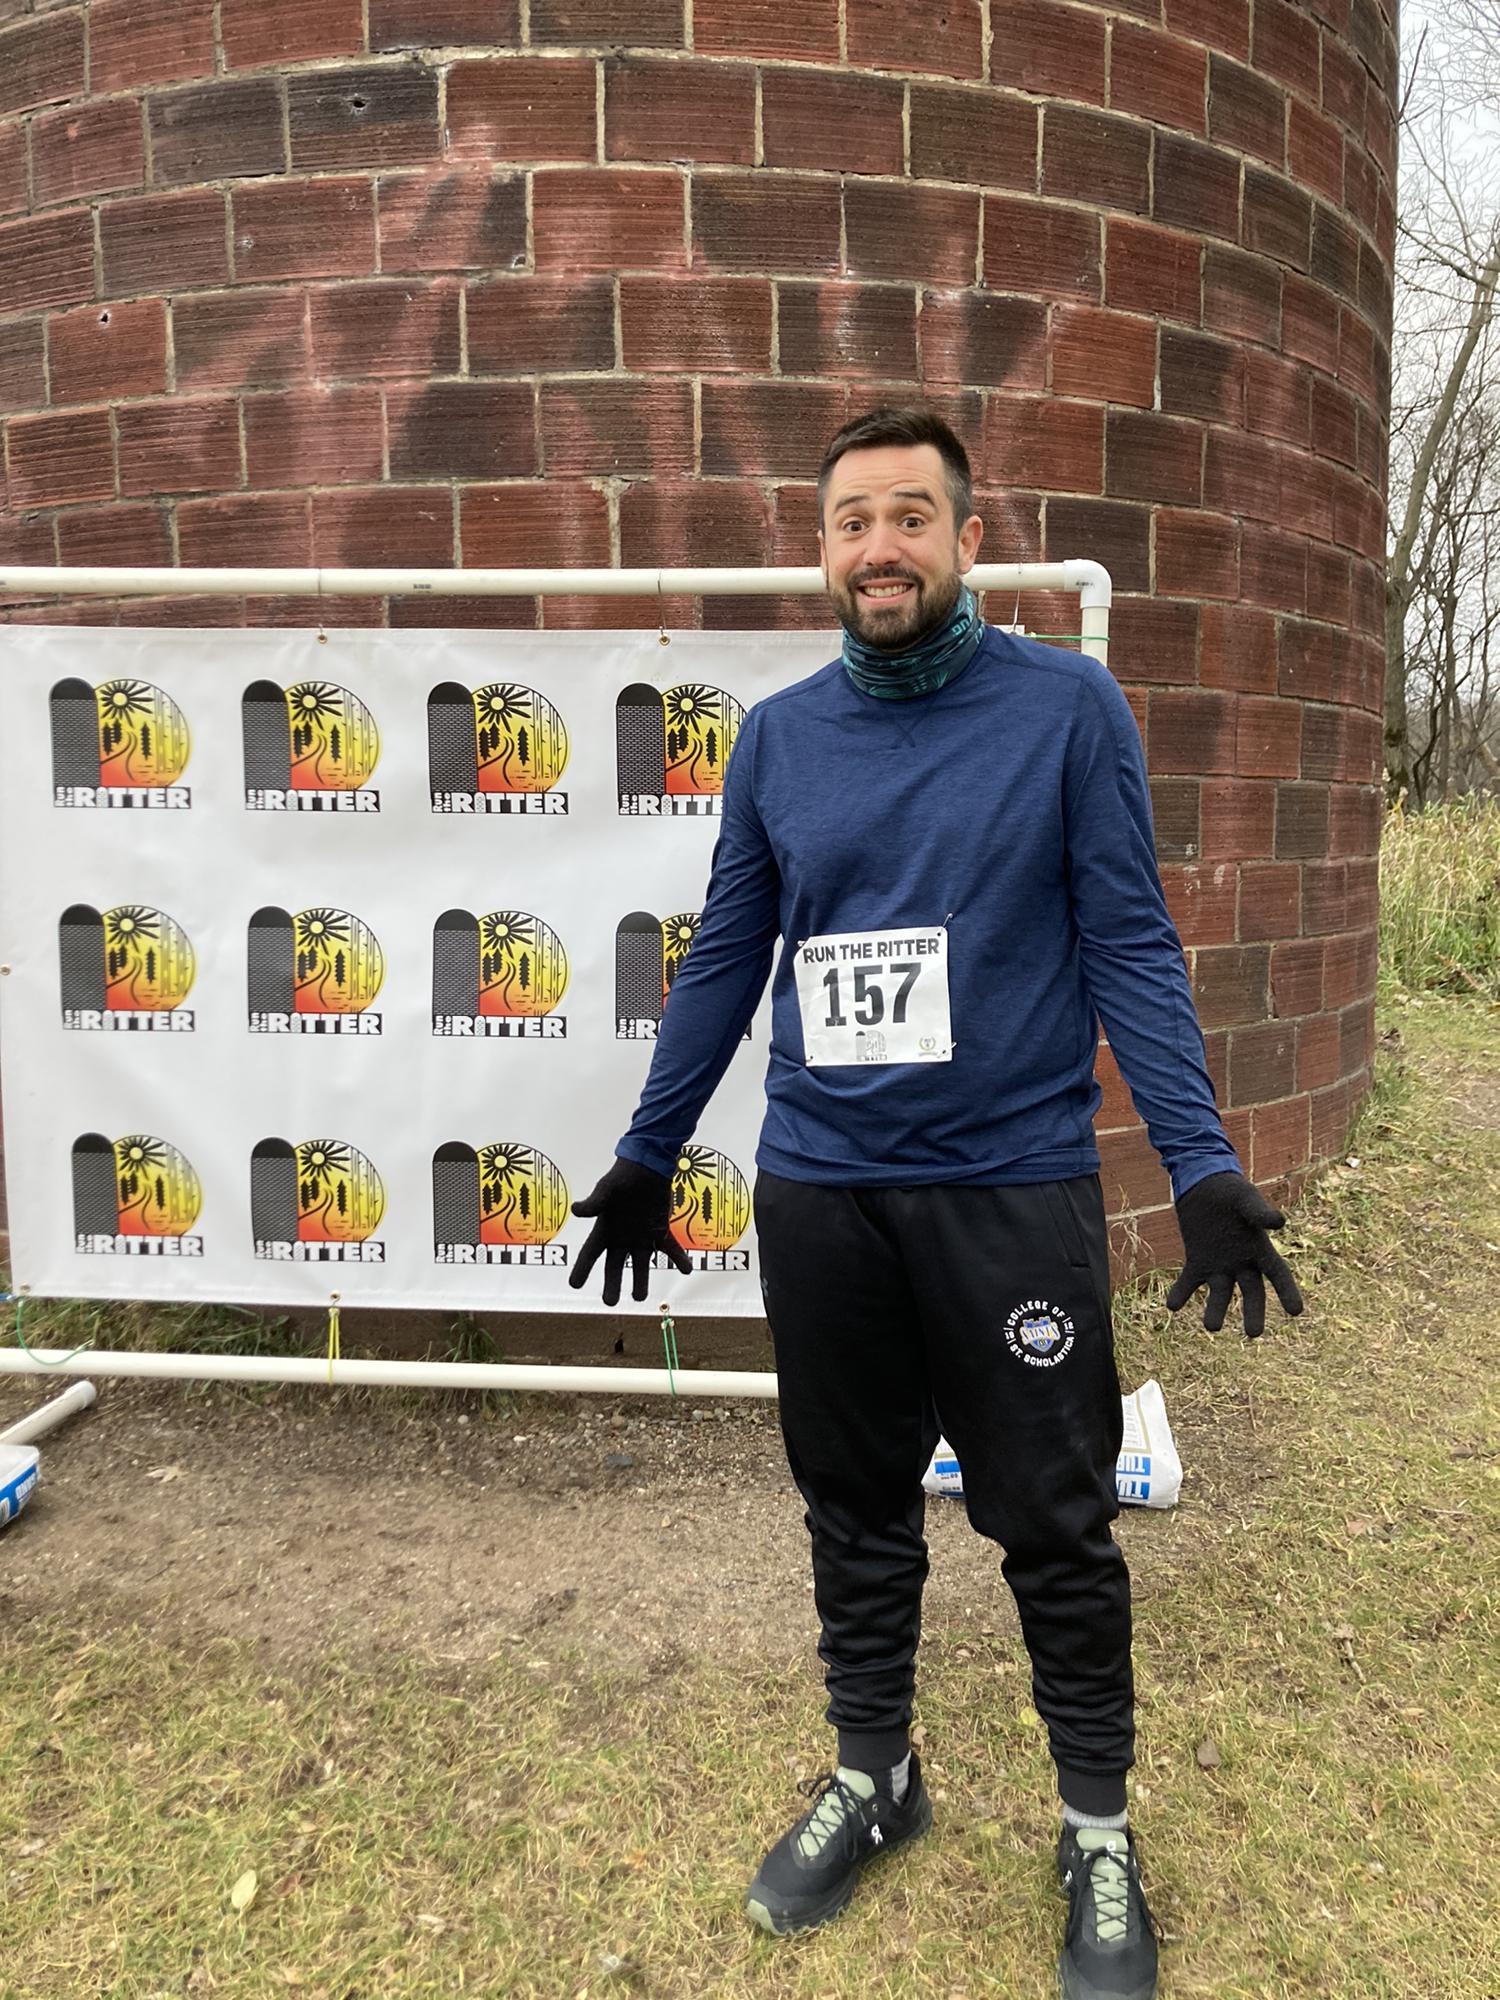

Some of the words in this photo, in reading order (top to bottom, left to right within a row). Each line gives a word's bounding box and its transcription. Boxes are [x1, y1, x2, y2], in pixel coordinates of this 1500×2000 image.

[73, 787, 189, 808] RITTER
[265, 789, 378, 812] RITTER
[433, 792, 443, 812] Run
[443, 792, 451, 812] the
[451, 792, 567, 814] RITTER
[619, 794, 630, 814] Run
[630, 794, 638, 814] the
[803, 945, 836, 963] RUN
[839, 943, 873, 960] THE
[877, 938, 939, 957] RITTER
[823, 962, 921, 1027] 157
[80, 1010, 193, 1031] RITTER
[267, 1013, 380, 1034] RITTER
[433, 1016, 443, 1035] Run
[443, 1016, 451, 1035] the
[451, 1015, 564, 1037] RITTER
[617, 1018, 627, 1038] Run
[627, 1018, 635, 1038] the
[93, 1234, 201, 1256] RITTER
[272, 1241, 383, 1262] RITTER
[453, 1244, 566, 1265] RITTER
[1007, 1300, 1048, 1326] COLLEGE
[1051, 1306, 1066, 1318] OF
[1009, 1343, 1024, 1358] ST.
[1023, 1336, 1075, 1367] SCHOLASTICA
